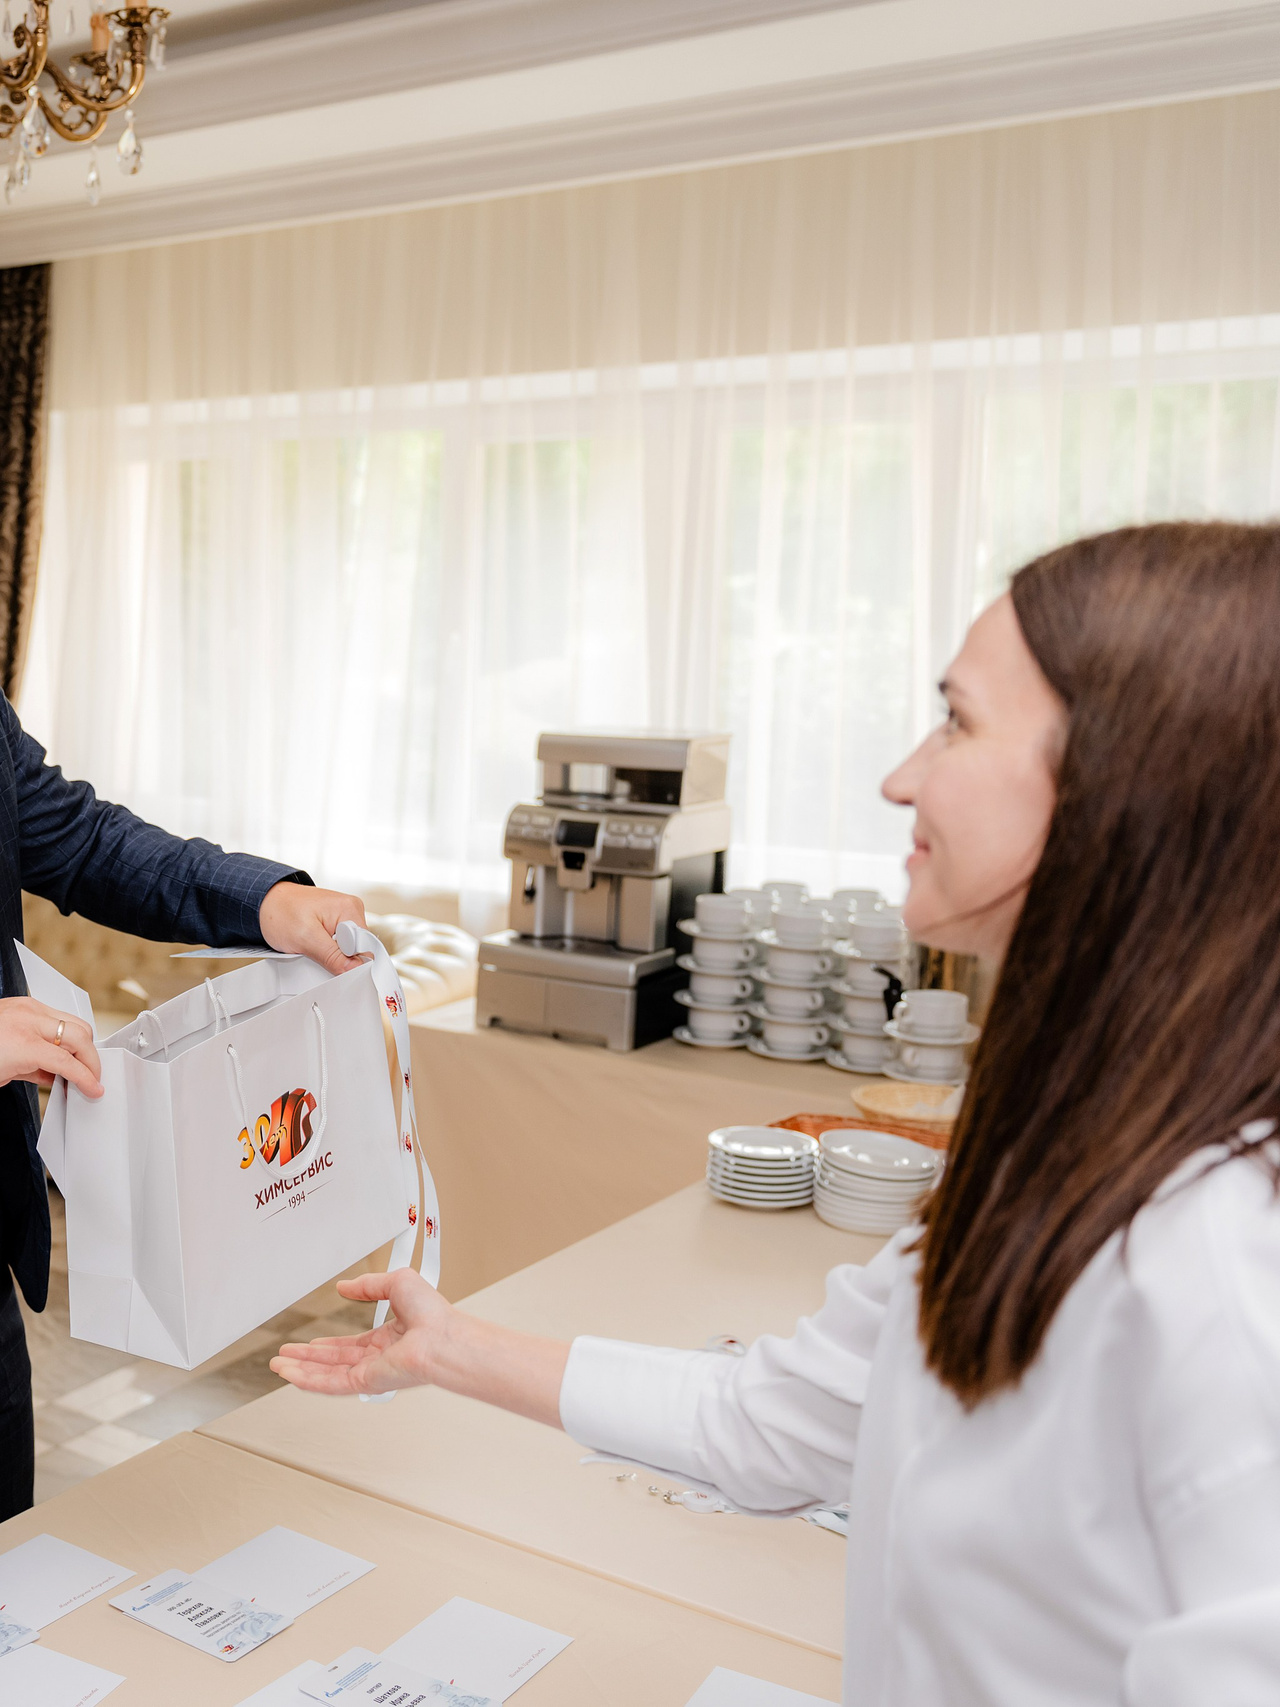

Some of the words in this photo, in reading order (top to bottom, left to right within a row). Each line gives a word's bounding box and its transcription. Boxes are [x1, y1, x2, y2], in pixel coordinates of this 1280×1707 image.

[237, 1113, 271, 1170] 30
[288, 1190, 306, 1209] 1994
[176, 1601, 204, 1617] Терехов
[187, 1605, 215, 1623] Алексей
[195, 1609, 226, 1629] Павлович
[373, 1685, 402, 1704] Шаткова
[389, 1692, 410, 1706] Ирина
